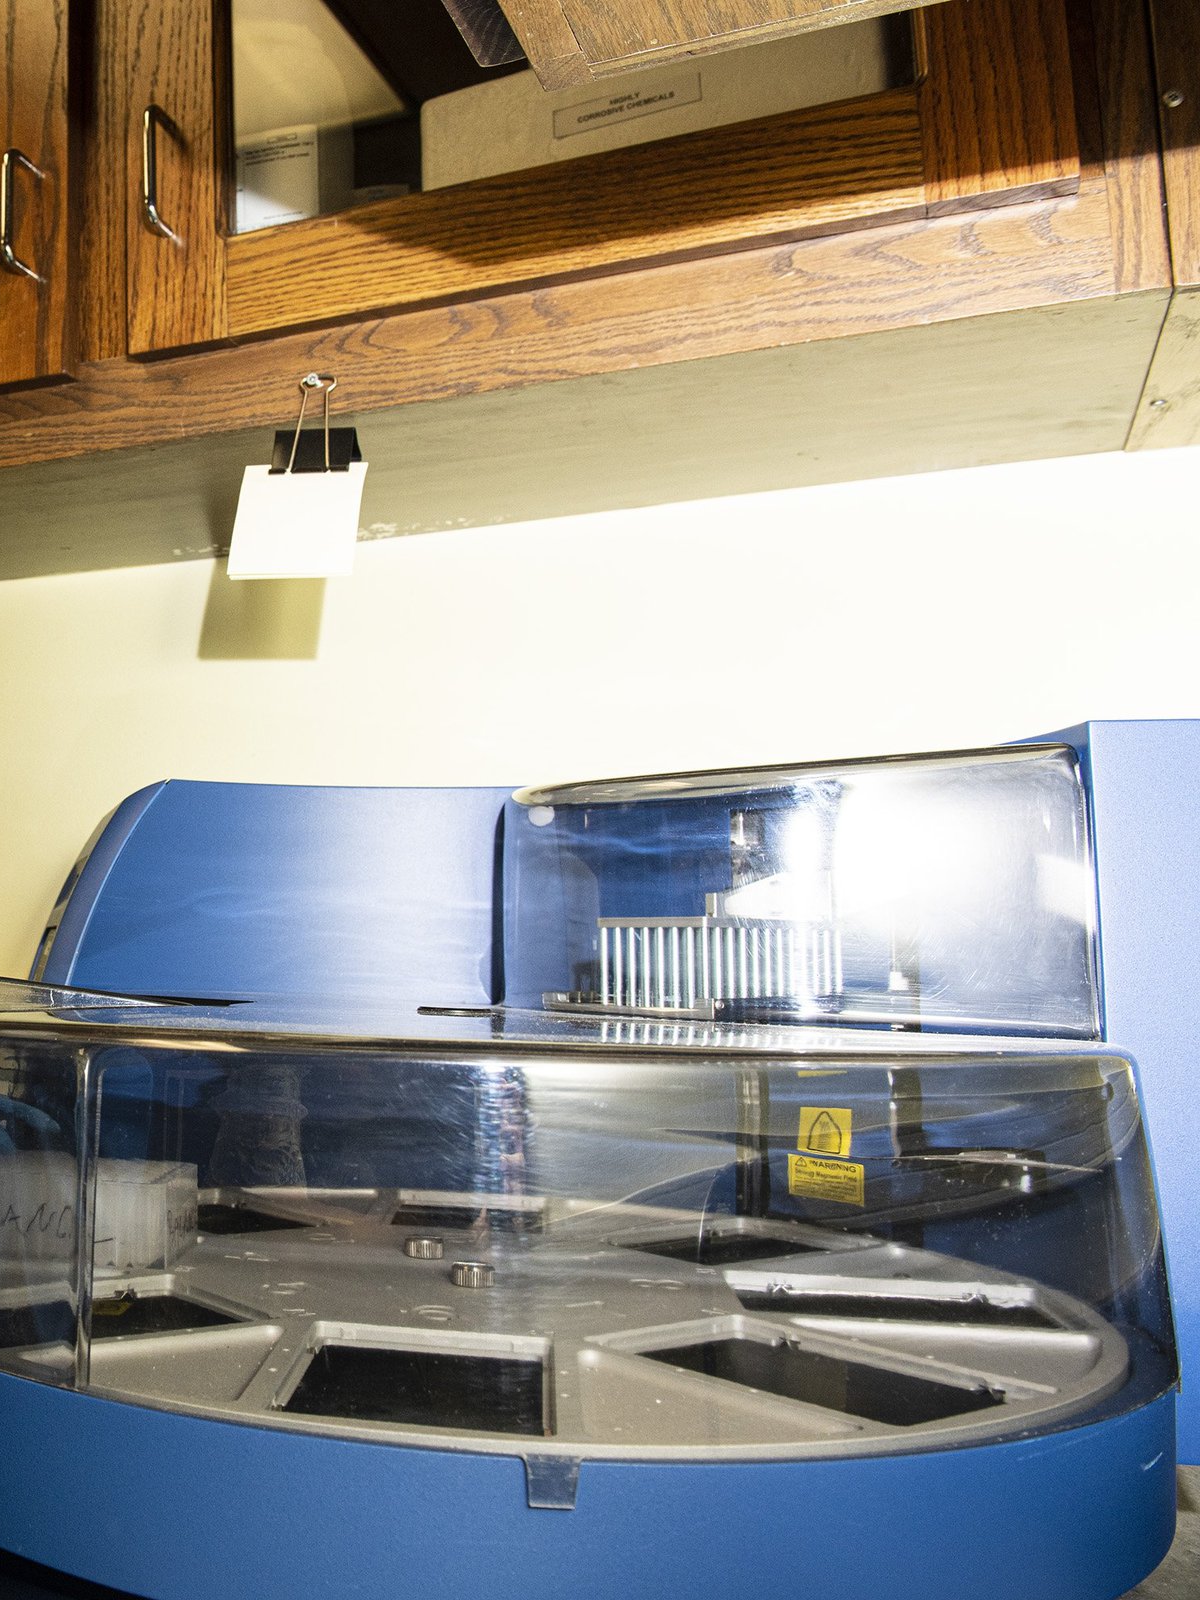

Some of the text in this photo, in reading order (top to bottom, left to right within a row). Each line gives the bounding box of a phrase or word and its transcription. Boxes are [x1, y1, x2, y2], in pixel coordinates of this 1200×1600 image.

[609, 91, 640, 105] HIGHLY
[577, 91, 675, 123] CORROSIVE CHEMICALS
[810, 1160, 857, 1173] WARNING
